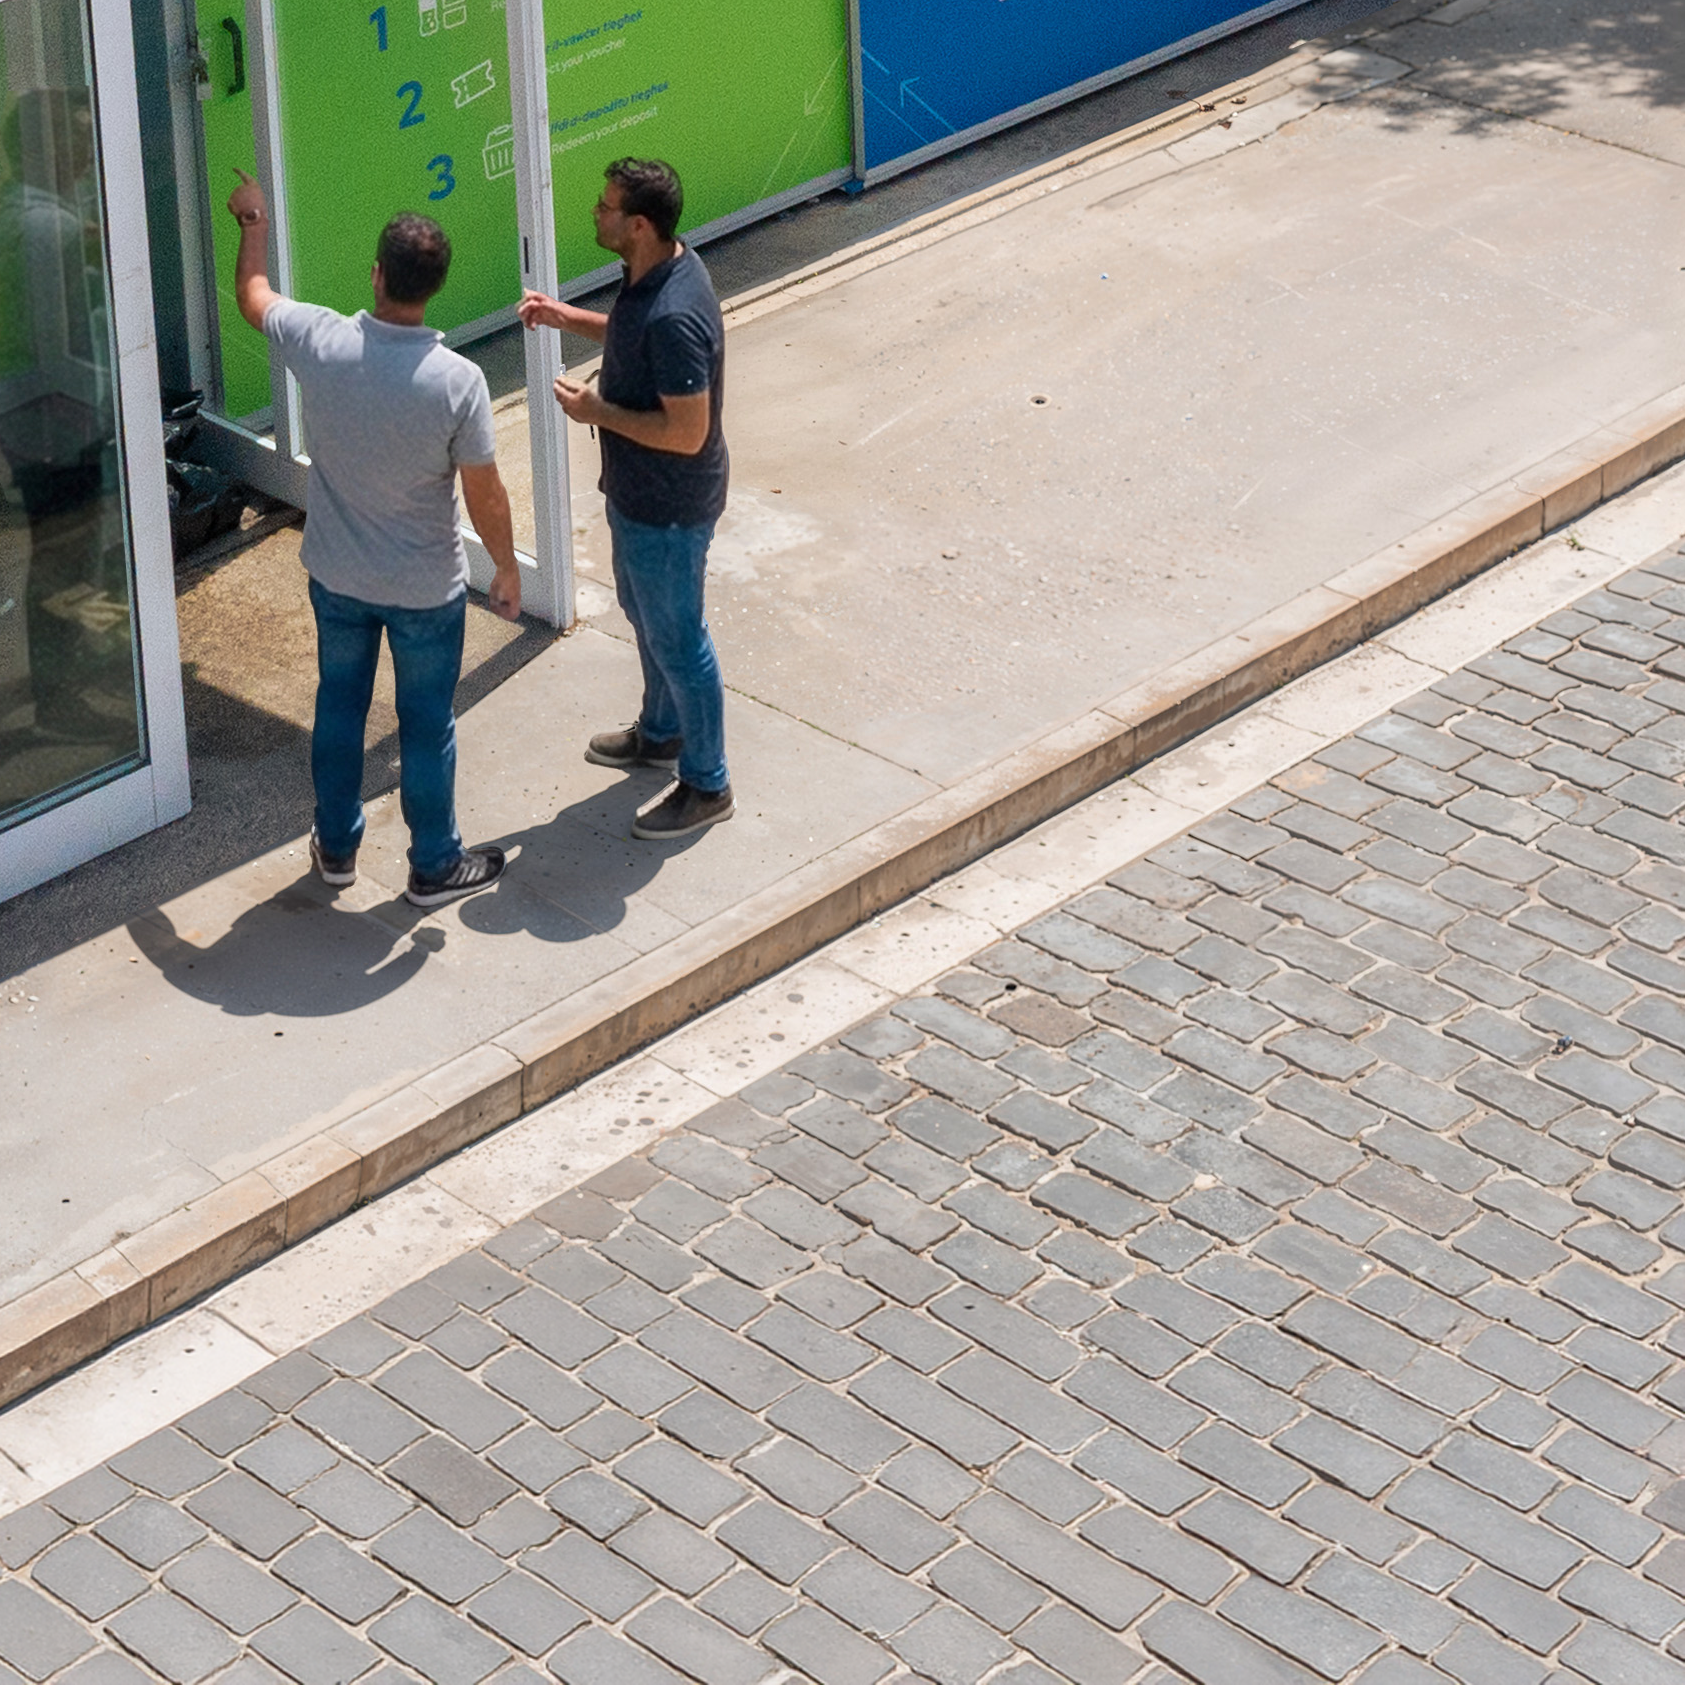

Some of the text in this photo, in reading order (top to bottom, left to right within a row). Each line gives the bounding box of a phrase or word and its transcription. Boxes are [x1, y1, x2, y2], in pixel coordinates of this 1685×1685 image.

[368, 5, 389, 52] 1
[396, 80, 425, 130] 2
[426, 154, 456, 202] 3
